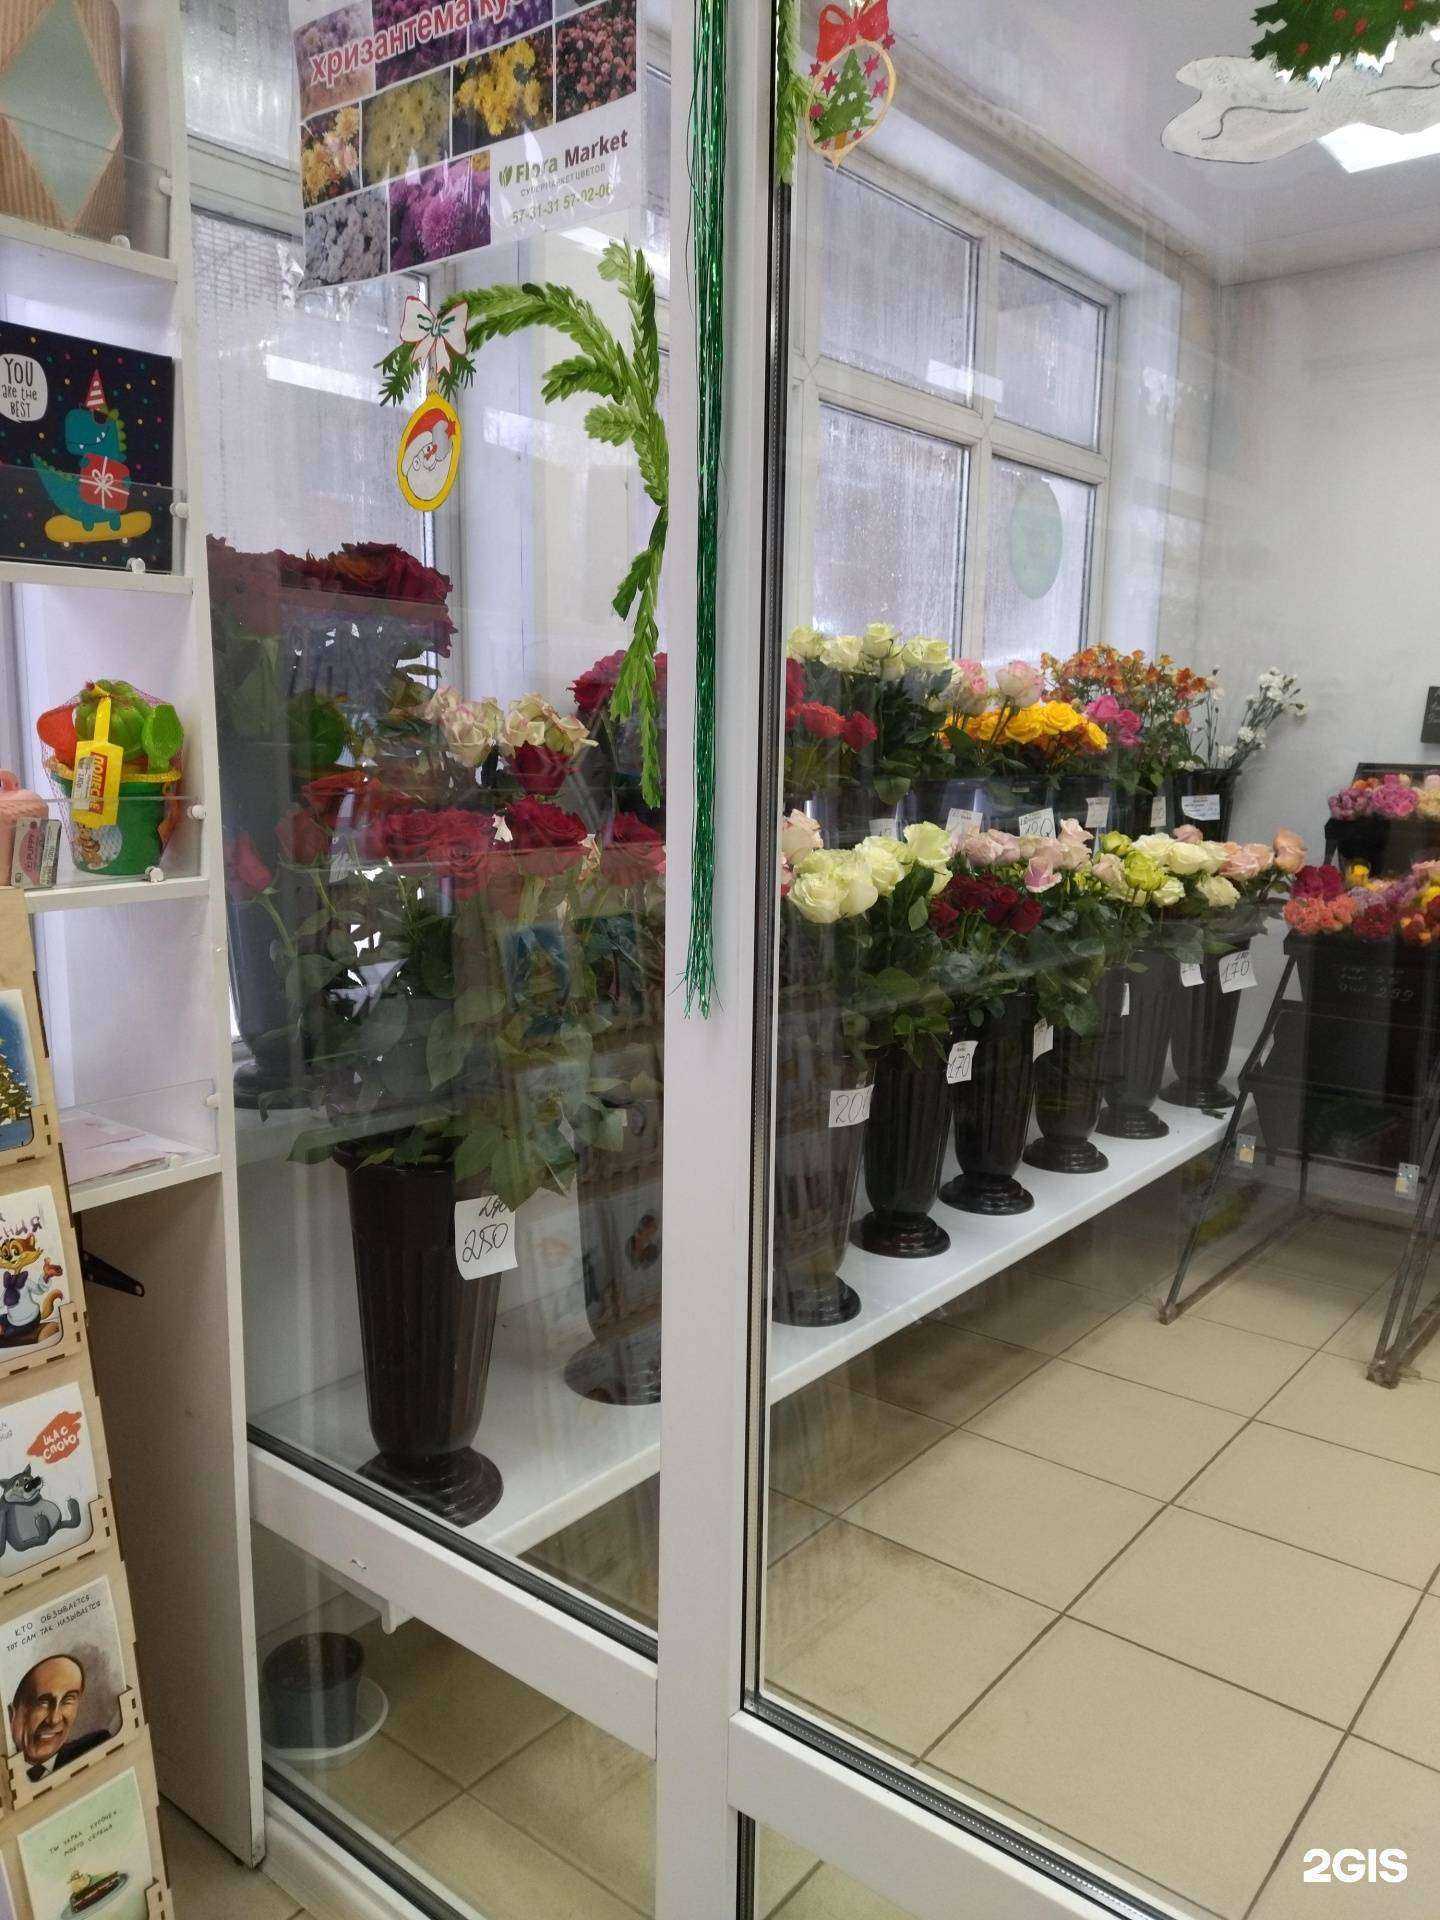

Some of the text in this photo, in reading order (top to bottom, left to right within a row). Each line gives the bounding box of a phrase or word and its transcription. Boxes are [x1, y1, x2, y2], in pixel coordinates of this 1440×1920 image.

[309, 0, 472, 84] хризантема
[564, 129, 628, 168] Market
[3, 356, 33, 387] YOU
[10, 400, 31, 418] BEST
[462, 1222, 509, 1263] 250
[14, 1622, 33, 1637] КТО
[21, 1633, 36, 1646] САМ
[40, 1624, 53, 1636] ТАК
